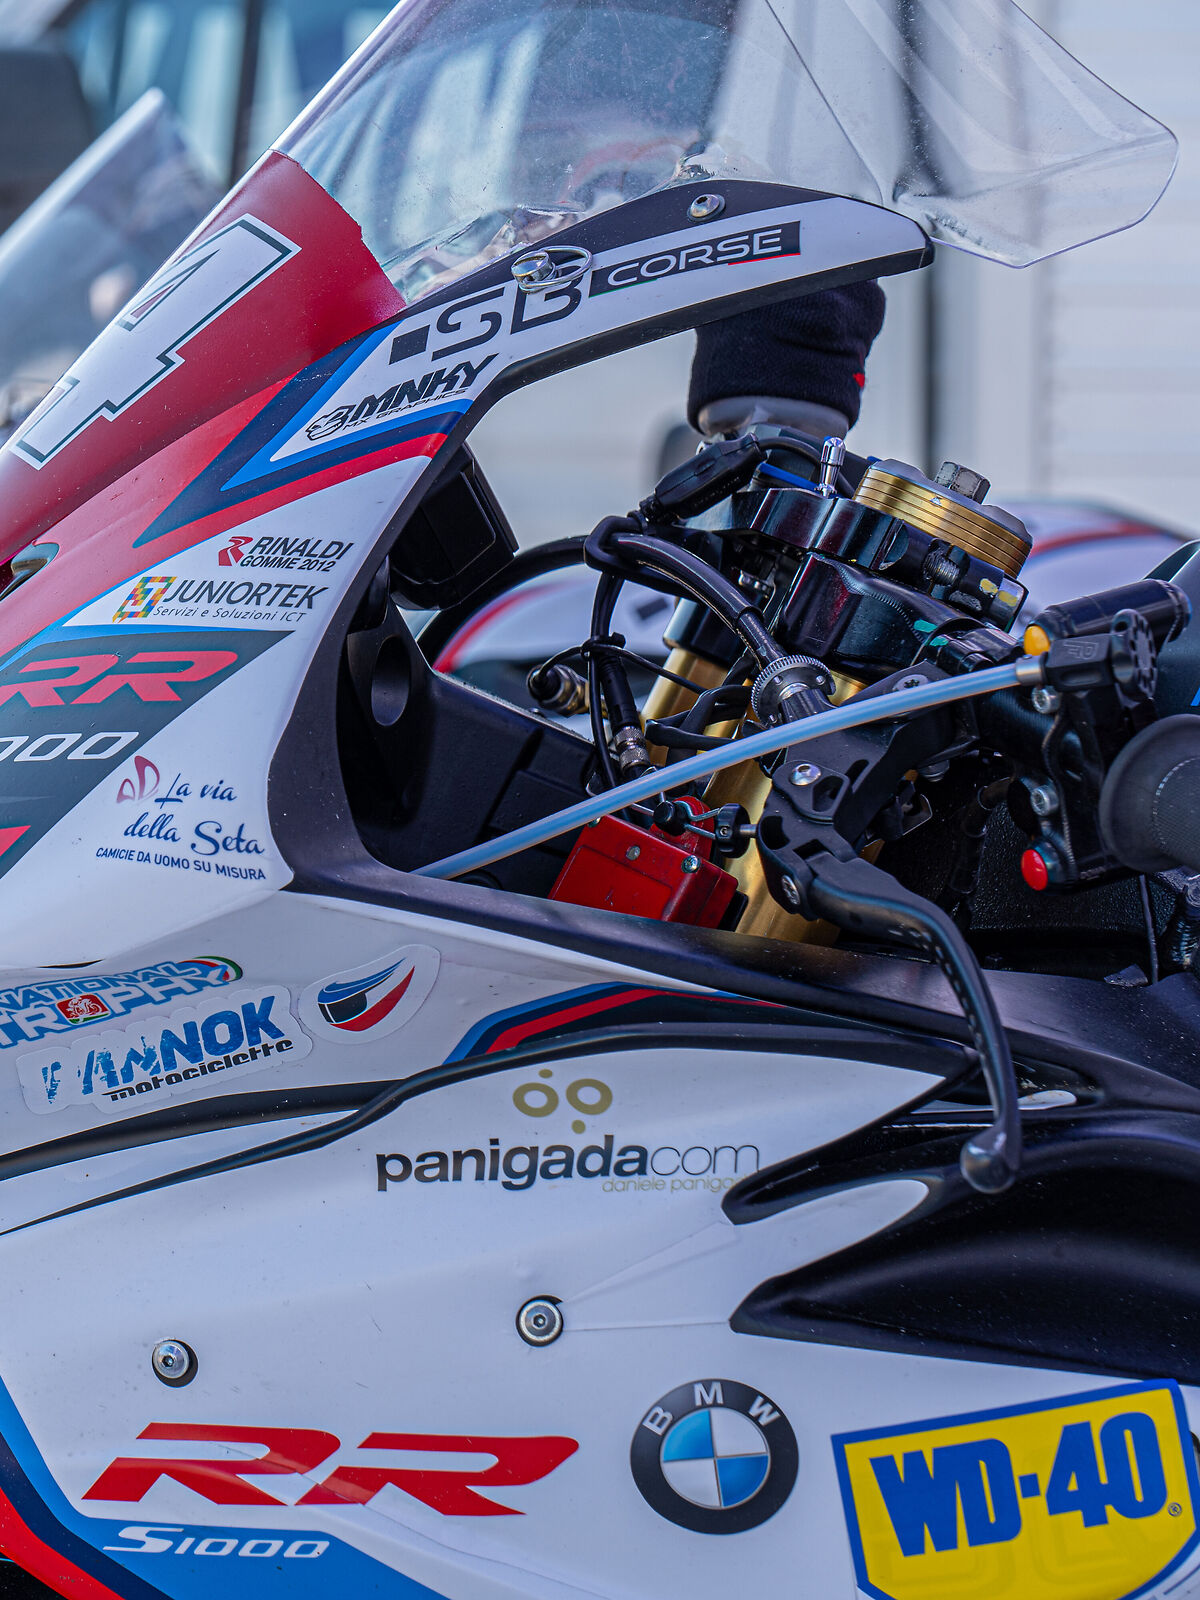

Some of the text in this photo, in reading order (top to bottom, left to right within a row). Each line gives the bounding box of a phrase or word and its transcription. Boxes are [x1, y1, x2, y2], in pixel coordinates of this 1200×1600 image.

[607, 228, 783, 286] CORSE
[349, 352, 500, 422] MNKY
[342, 387, 469, 431] MX GRAPHICS
[240, 555, 337, 573] GOMME 2012
[248, 536, 355, 560] RINALDI
[153, 605, 308, 624] Servizi e Soluzioni ICT
[163, 579, 329, 610] JUNIORTEK
[154, 772, 237, 809] La via
[123, 811, 265, 857] della Seta
[95, 846, 267, 880] CAMICIE DA UOMO SU MISURA
[101, 1039, 294, 1102] motociclette
[602, 1174, 747, 1193] daniele paniga
[642, 1380, 782, 1436] BMW
[81, 1422, 580, 1516] RR
[869, 1411, 1168, 1557] WD-40
[103, 1525, 330, 1559] S1000
